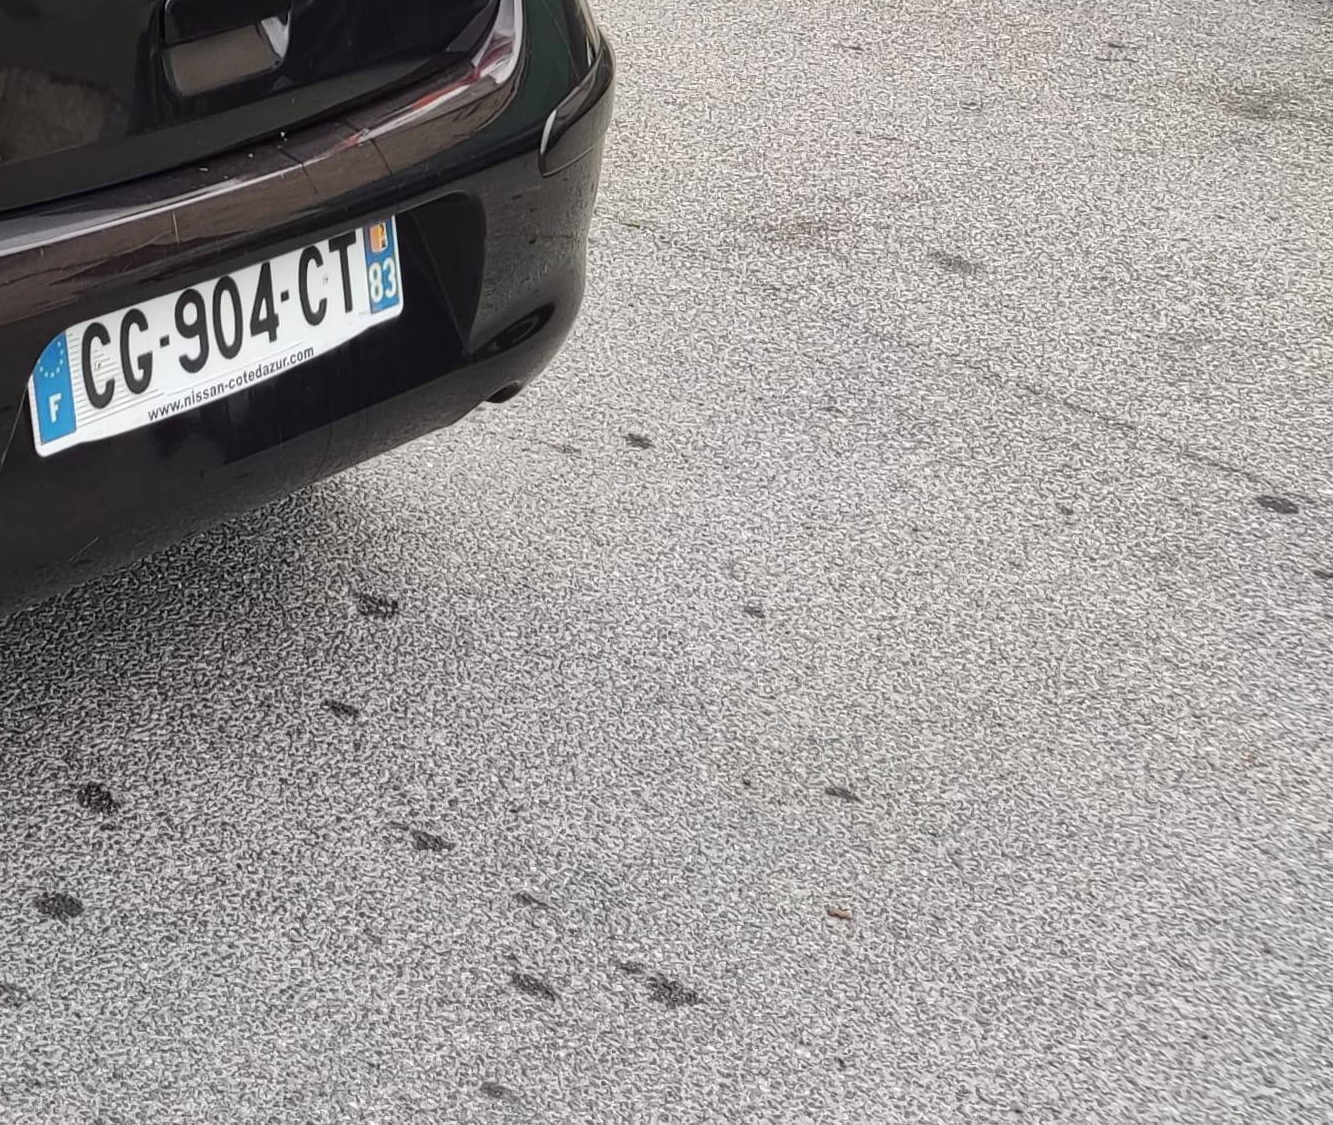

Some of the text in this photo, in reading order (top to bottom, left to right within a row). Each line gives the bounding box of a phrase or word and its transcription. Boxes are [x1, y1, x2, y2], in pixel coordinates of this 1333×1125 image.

[48, 232, 398, 424] F CG-904-CT 83
[147, 346, 315, 422] www.nissan-cotedazur.com
